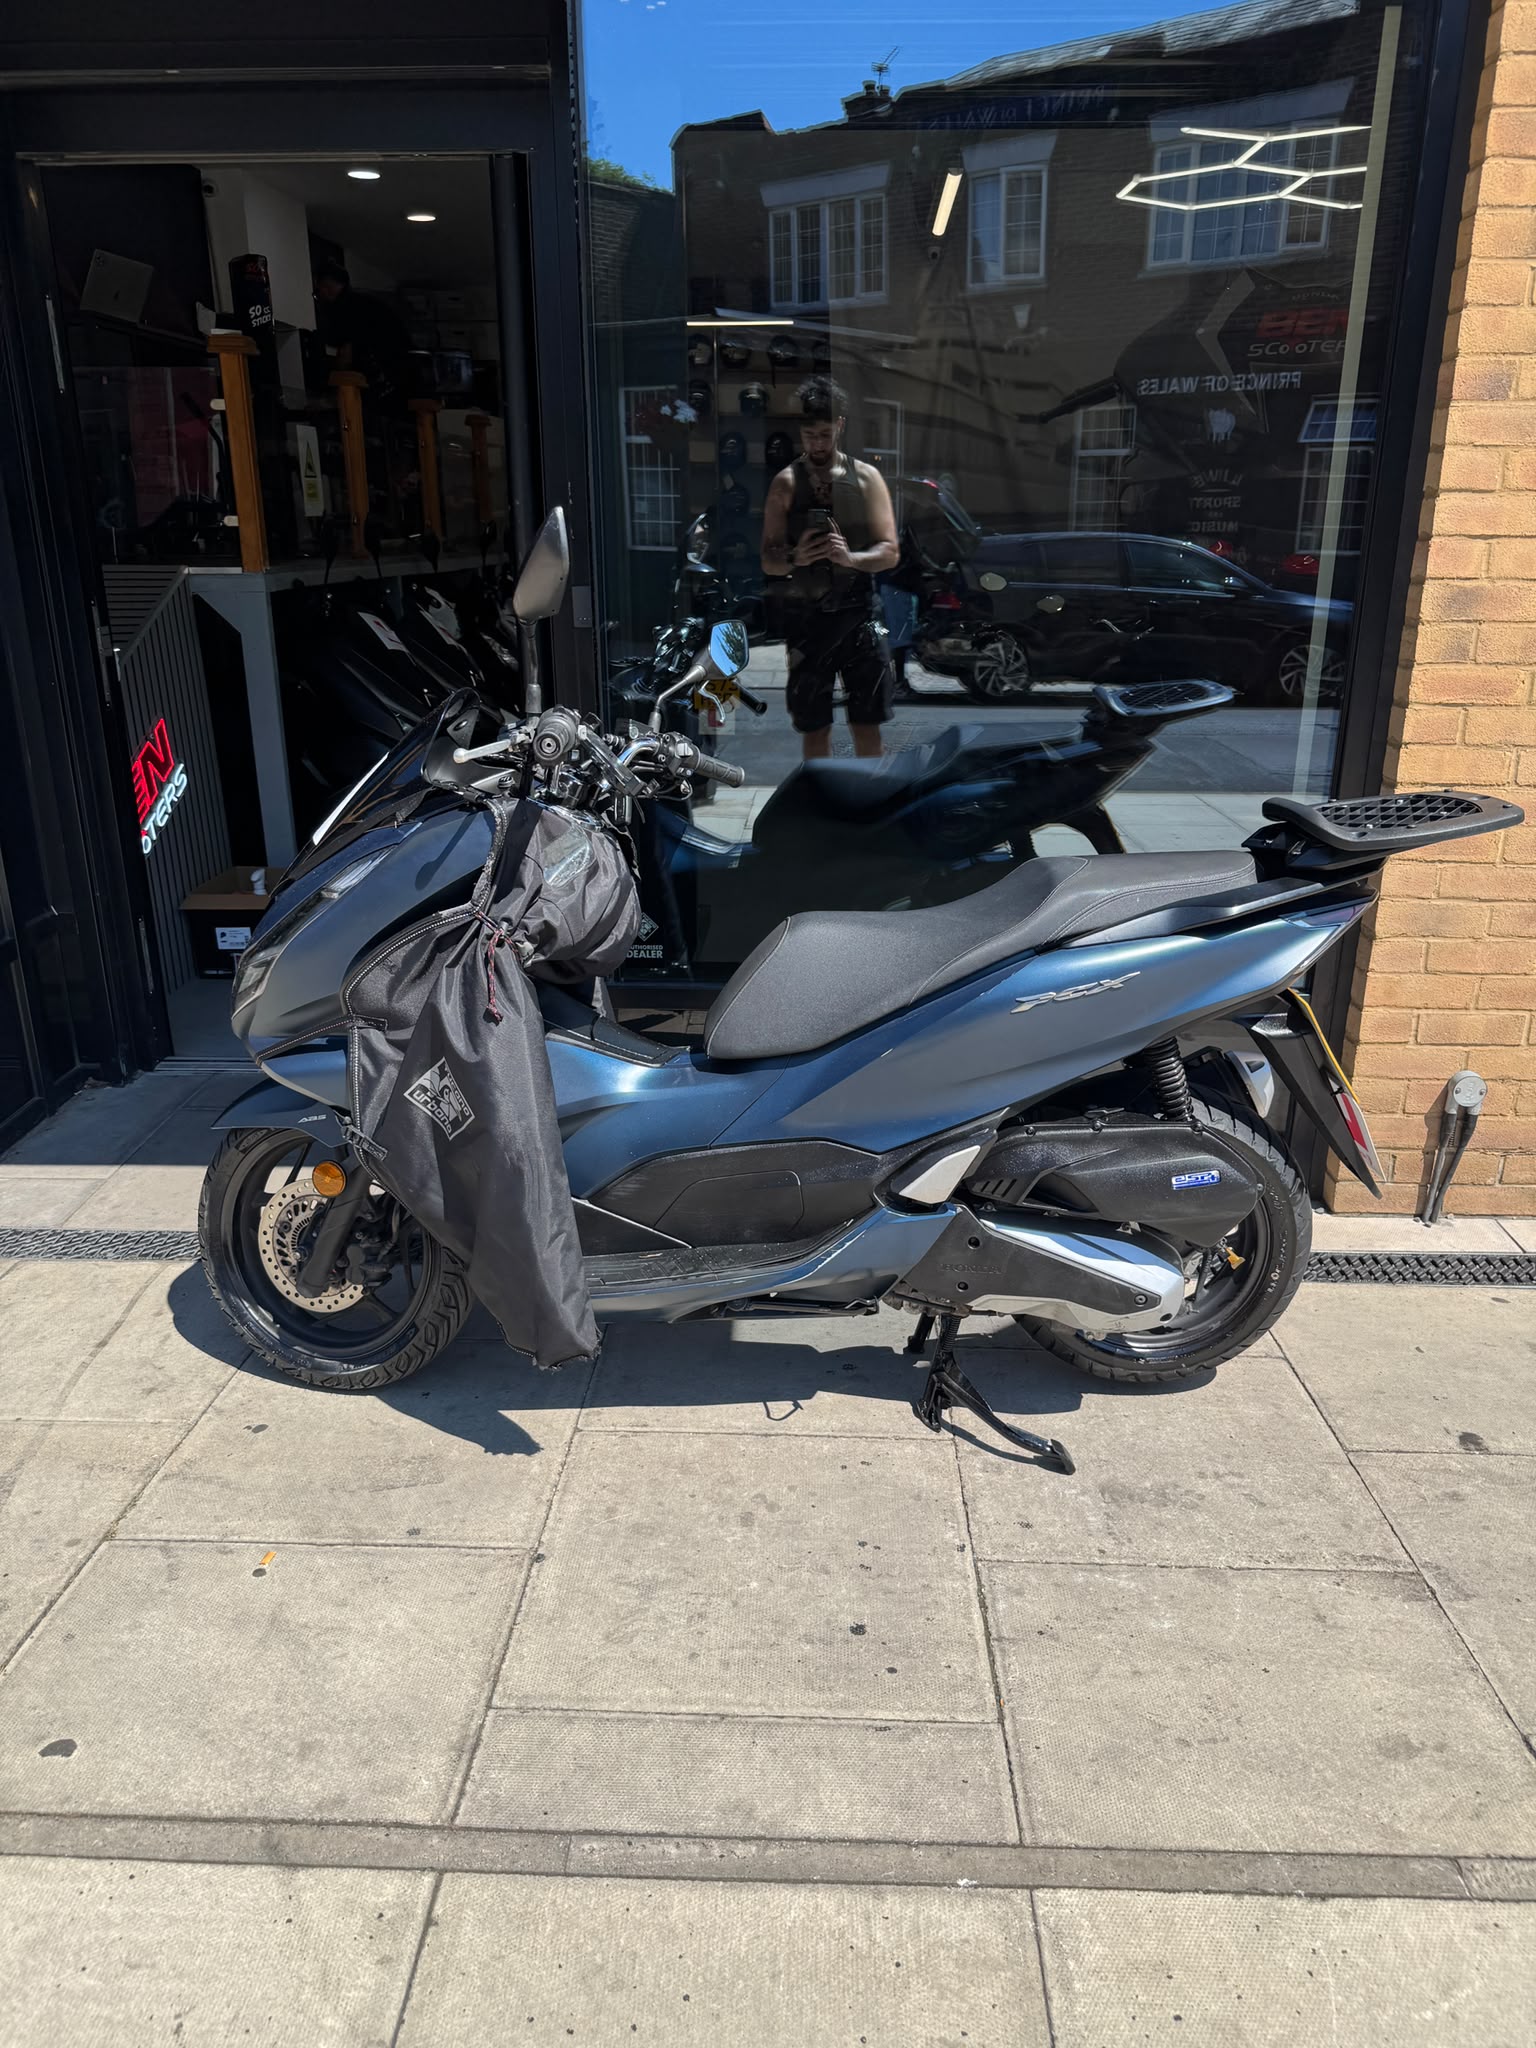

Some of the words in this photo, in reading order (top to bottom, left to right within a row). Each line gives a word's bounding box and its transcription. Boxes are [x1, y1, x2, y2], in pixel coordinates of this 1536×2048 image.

[626, 950, 664, 959] DEALER
[1010, 971, 1141, 1013] PCX
[297, 1113, 328, 1124] ABS
